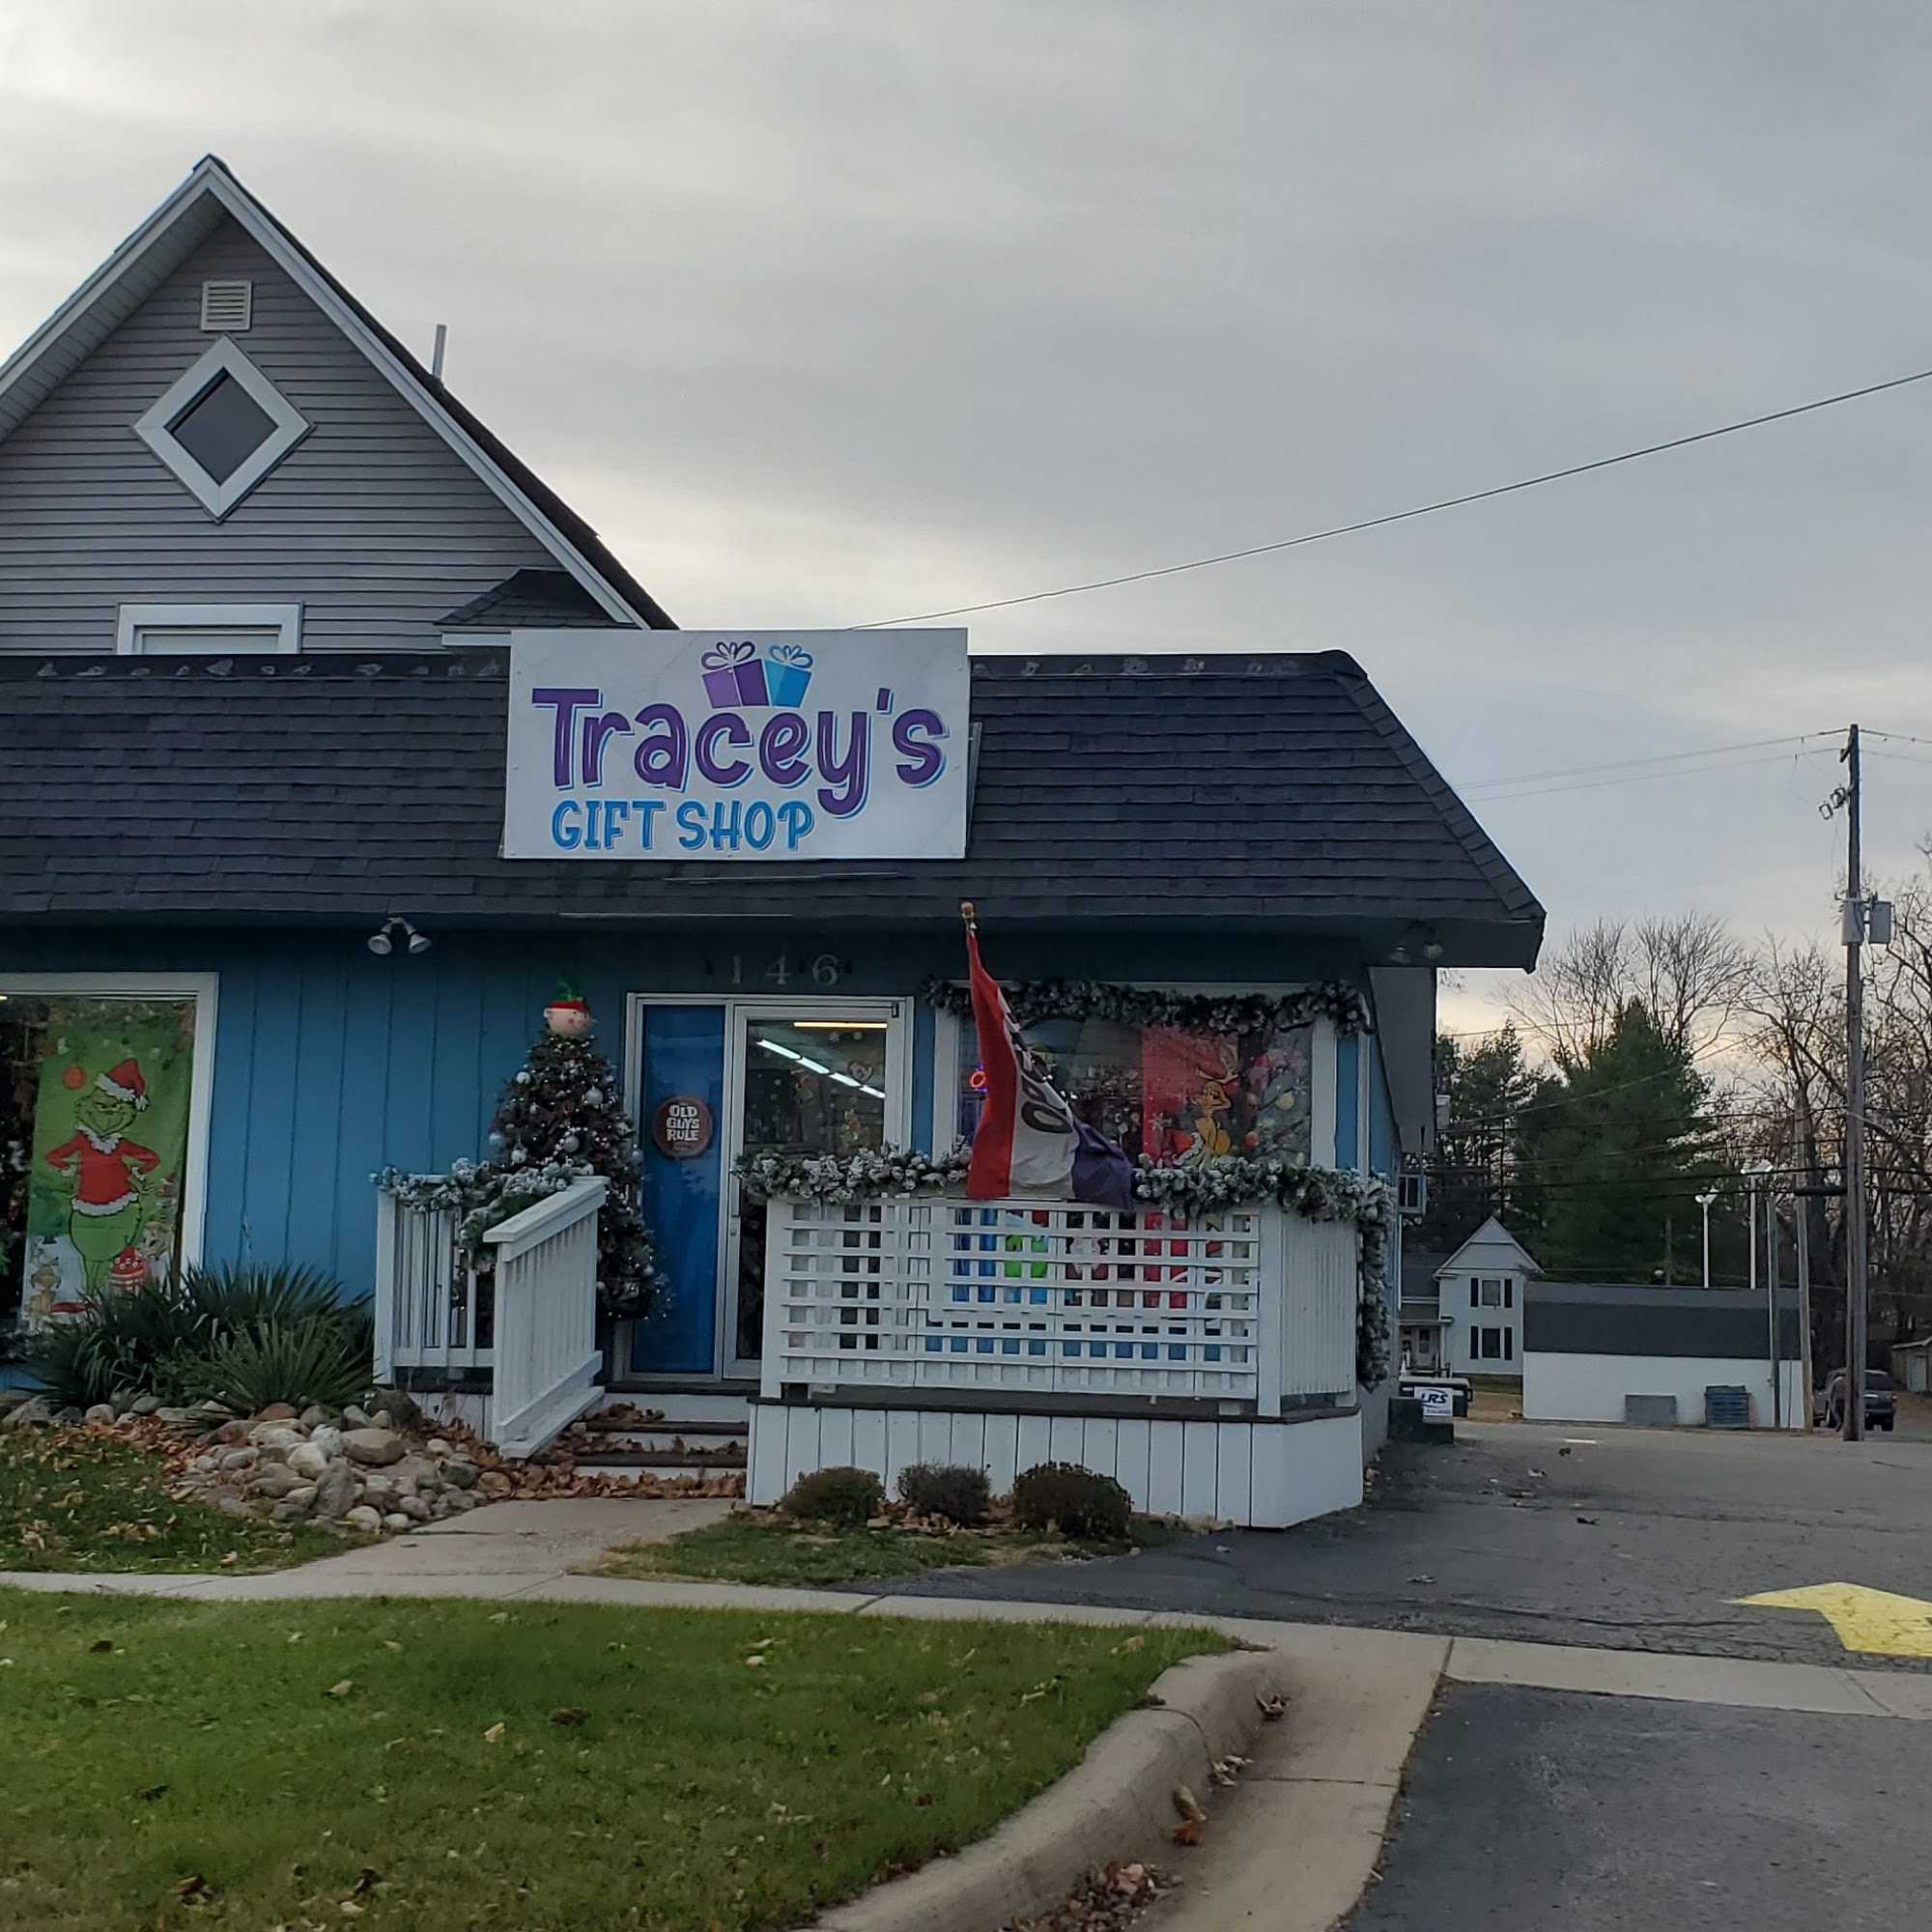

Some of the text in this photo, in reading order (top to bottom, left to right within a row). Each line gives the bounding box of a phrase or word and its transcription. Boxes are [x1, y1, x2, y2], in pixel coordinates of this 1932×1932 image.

[532, 688, 950, 818] Tracey's
[553, 800, 815, 850] GIFT SHOP
[732, 954, 838, 985] 146
[668, 1104, 697, 1118] OLD
[667, 1117, 700, 1129] GUYS
[667, 1128, 699, 1141] RULE
